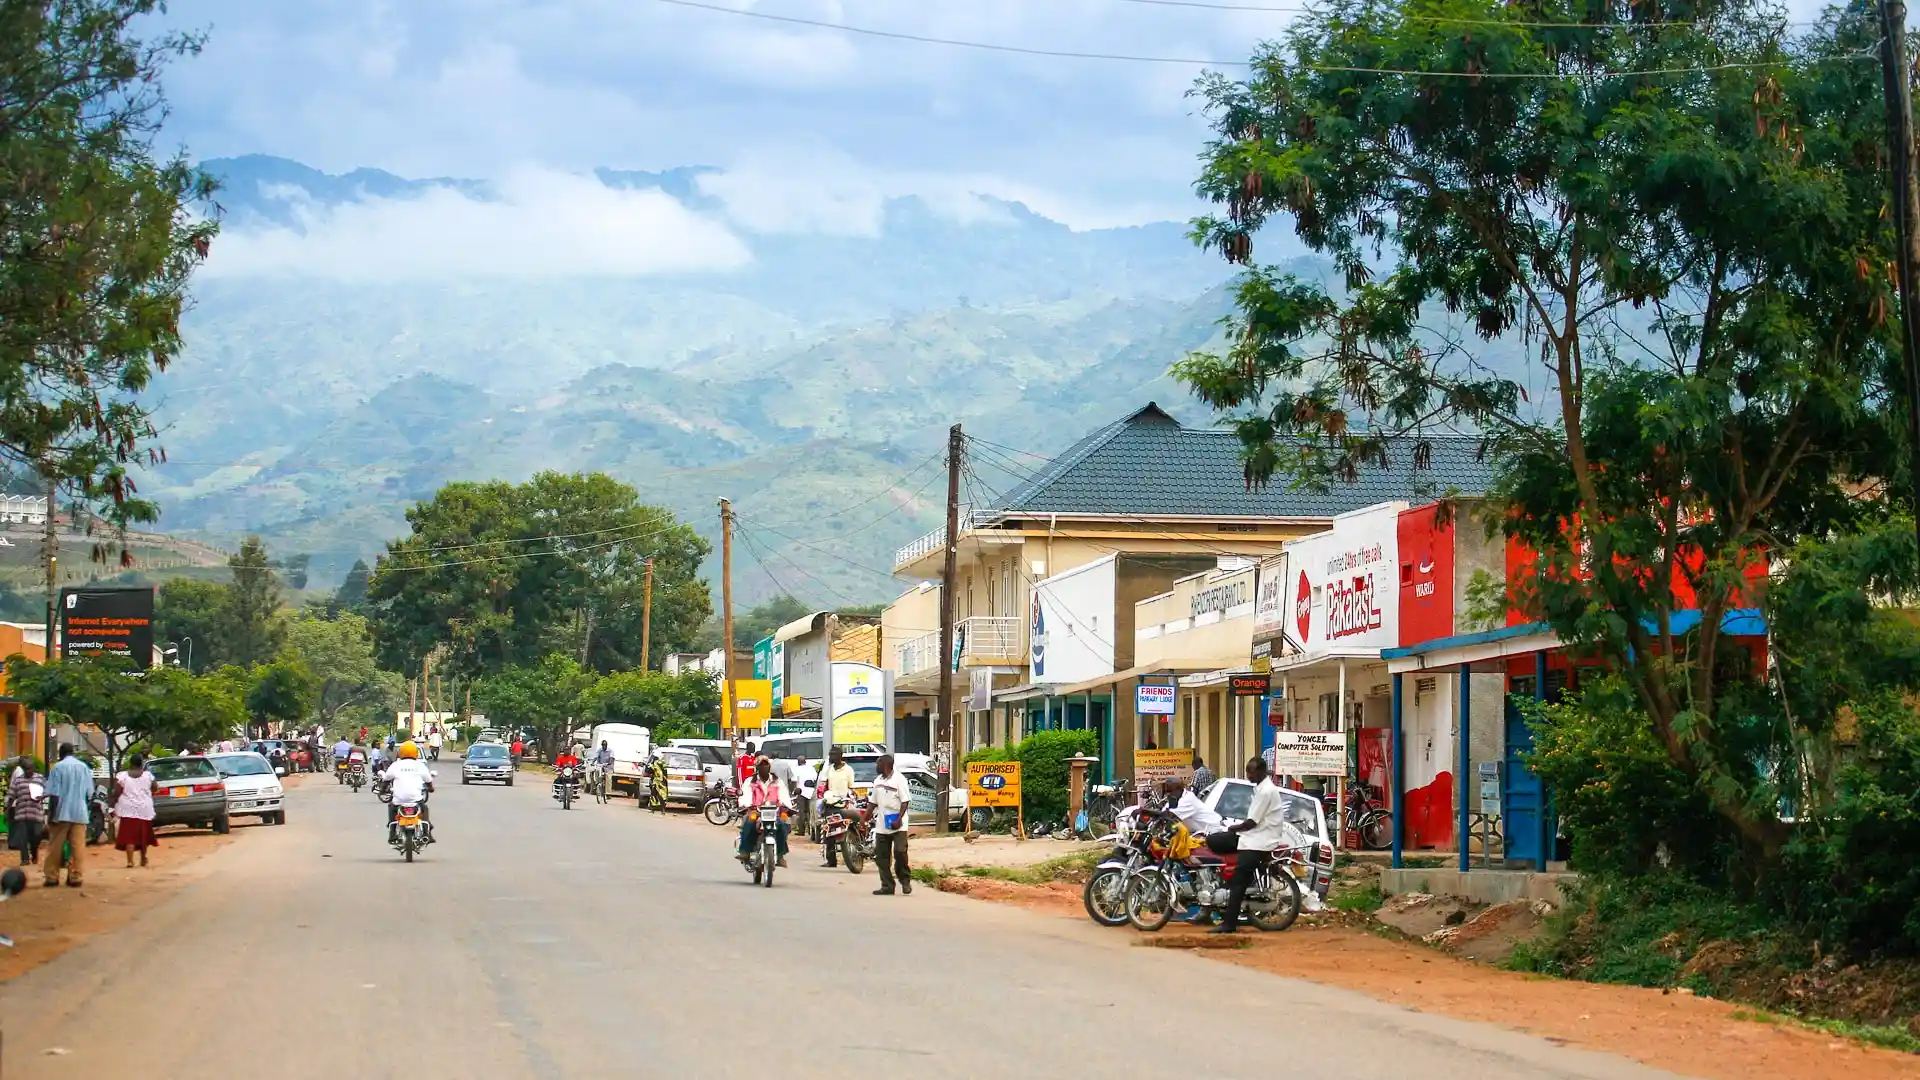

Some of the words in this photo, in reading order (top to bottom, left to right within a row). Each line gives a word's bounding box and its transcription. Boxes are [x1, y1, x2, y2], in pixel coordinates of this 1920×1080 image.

[101, 618, 148, 626] Everywhere
[68, 641, 95, 649] powered
[95, 641, 104, 649] by
[1232, 679, 1267, 689] Orange
[1141, 687, 1173, 696] FRIENDS
[736, 700, 758, 708] MTN
[1277, 743, 1309, 751] COMPUTER
[1310, 743, 1345, 752] SOLUTIONS
[970, 764, 1016, 774] AUTHORISED
[982, 776, 1001, 785] MTN
